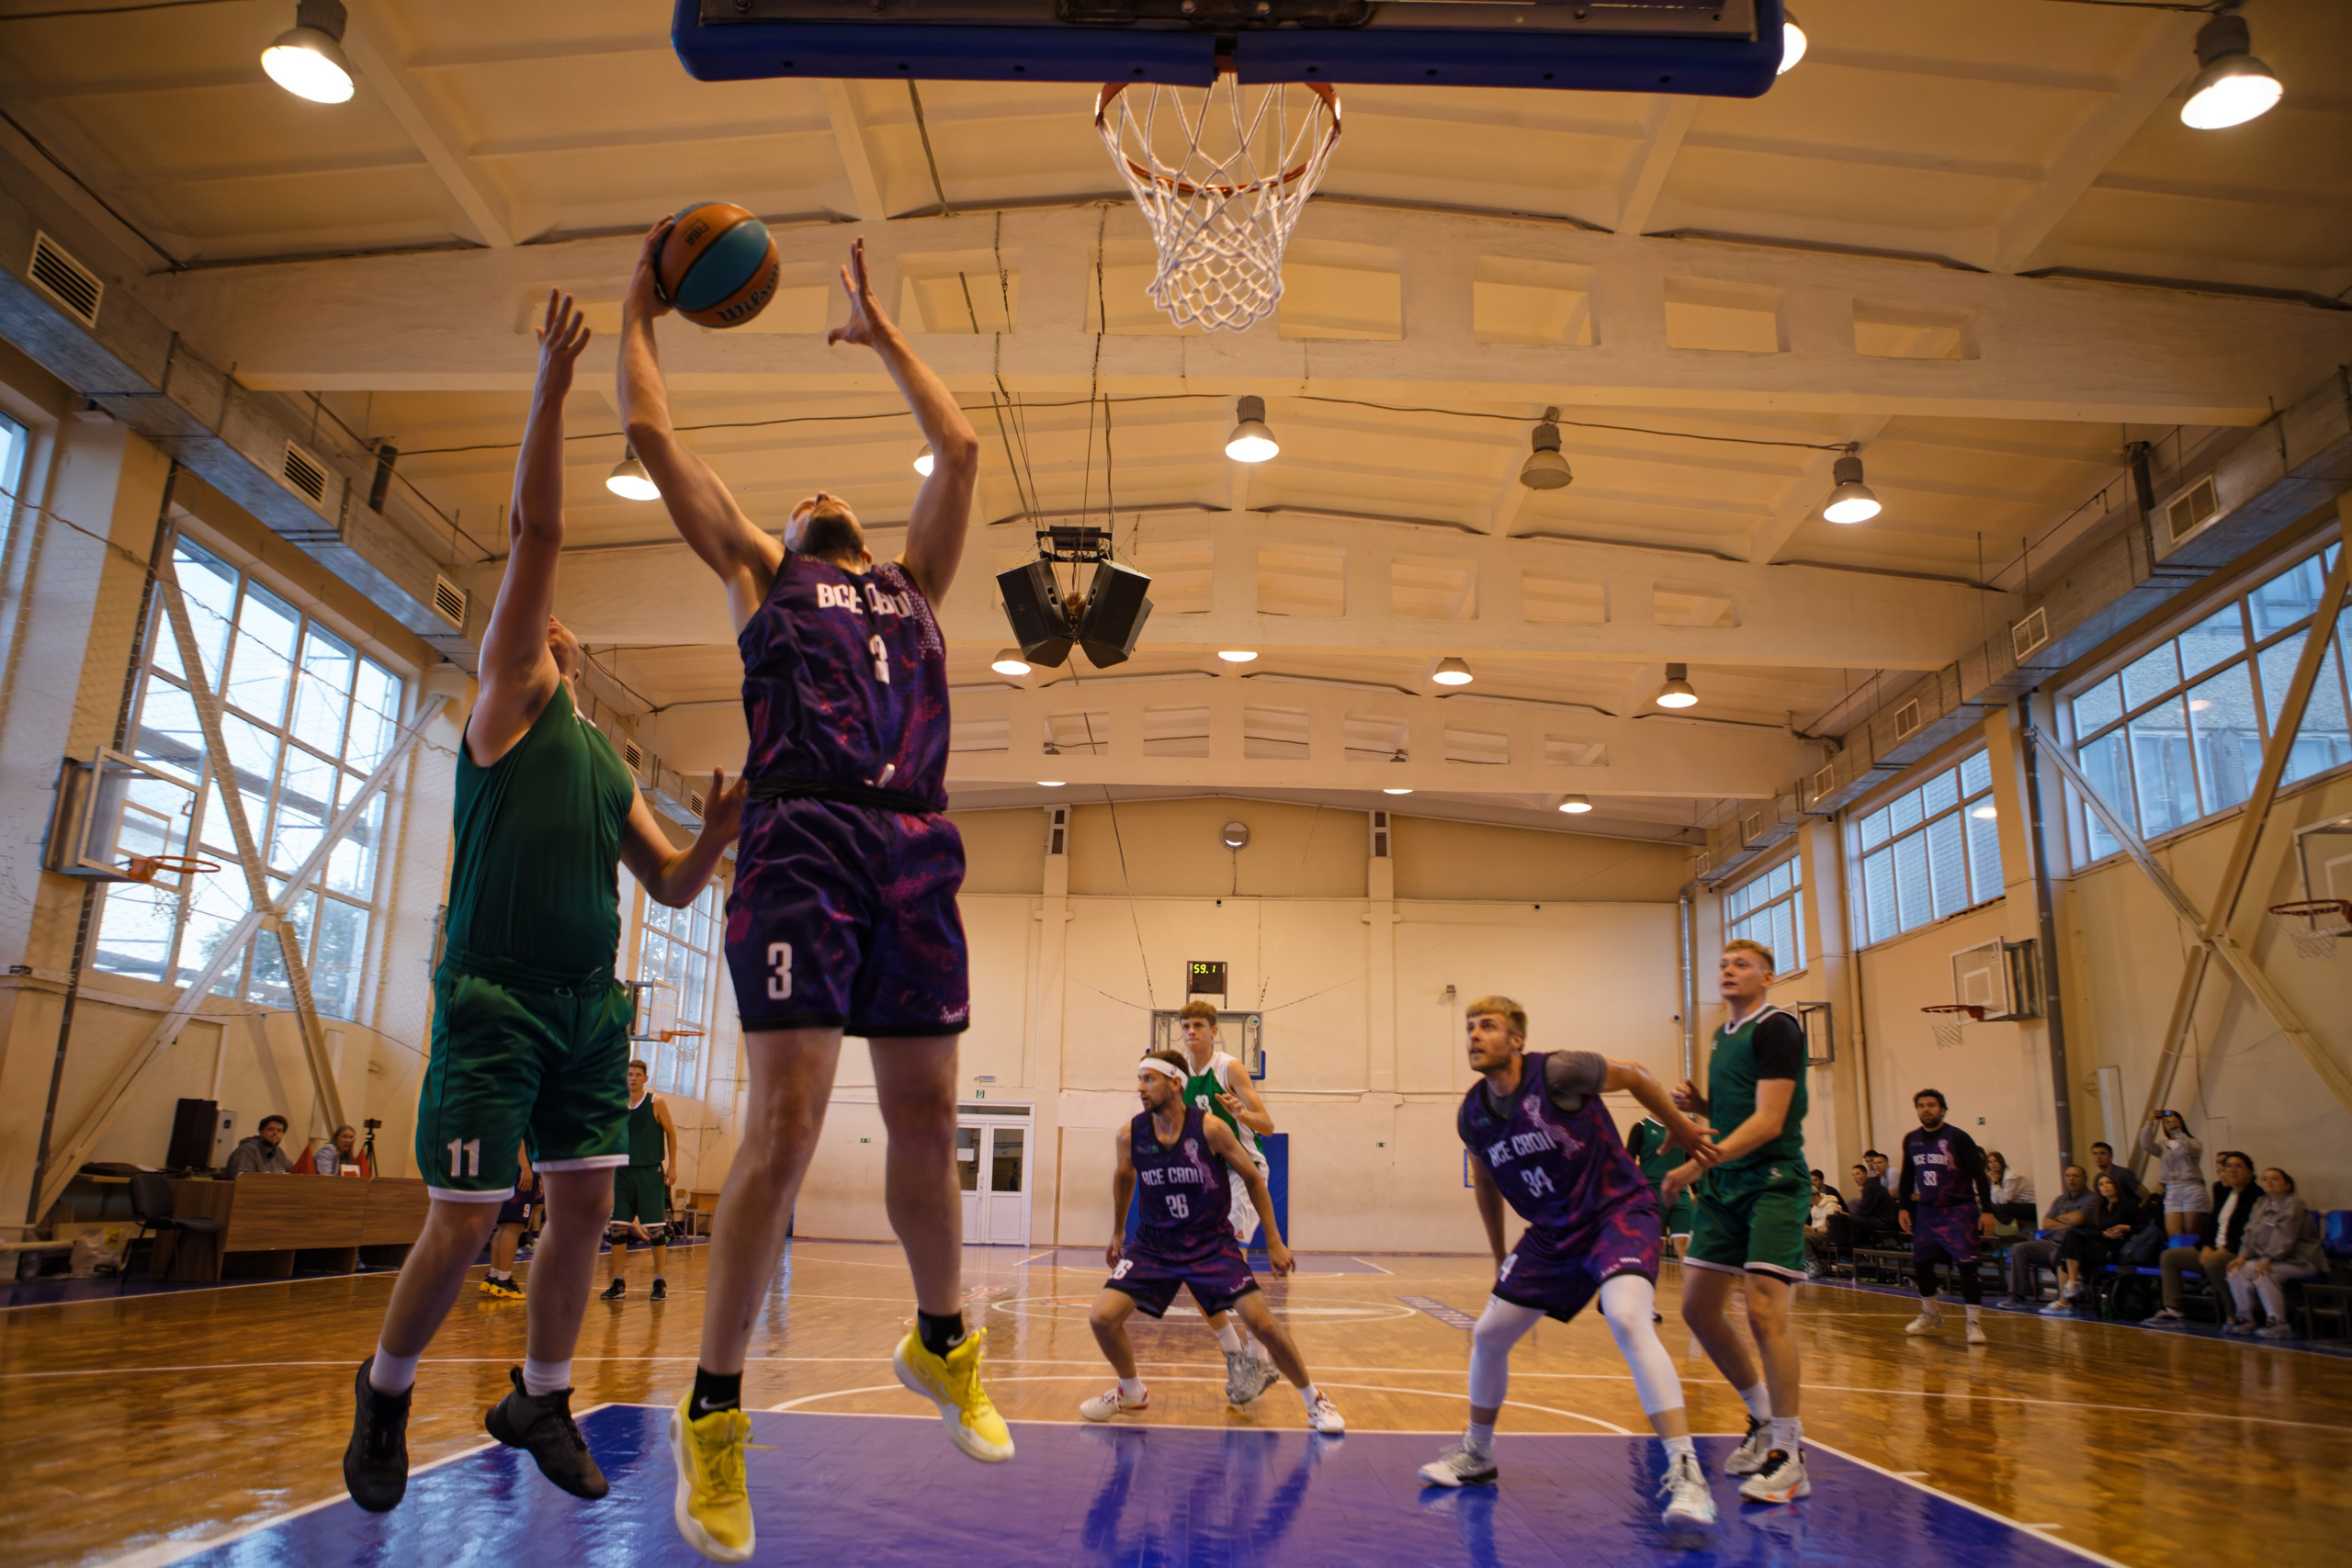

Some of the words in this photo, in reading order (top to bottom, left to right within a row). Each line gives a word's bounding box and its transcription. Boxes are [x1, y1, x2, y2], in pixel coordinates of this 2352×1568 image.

[817, 583, 864, 615] ВСЕ
[865, 582, 914, 619] СВО
[869, 634, 890, 684] 3
[767, 942, 793, 1001] 3
[1193, 964, 1216, 974] 59.1
[447, 1138, 480, 1178] 11
[1141, 1168, 1165, 1186] ВСЕ
[1521, 1166, 1555, 1198] 34
[1923, 1170, 1938, 1186] 33
[523, 1203, 531, 1218] 9
[1165, 1193, 1189, 1219] 26
[1110, 1258, 1134, 1280] 6
[1499, 1253, 1519, 1282] 4
